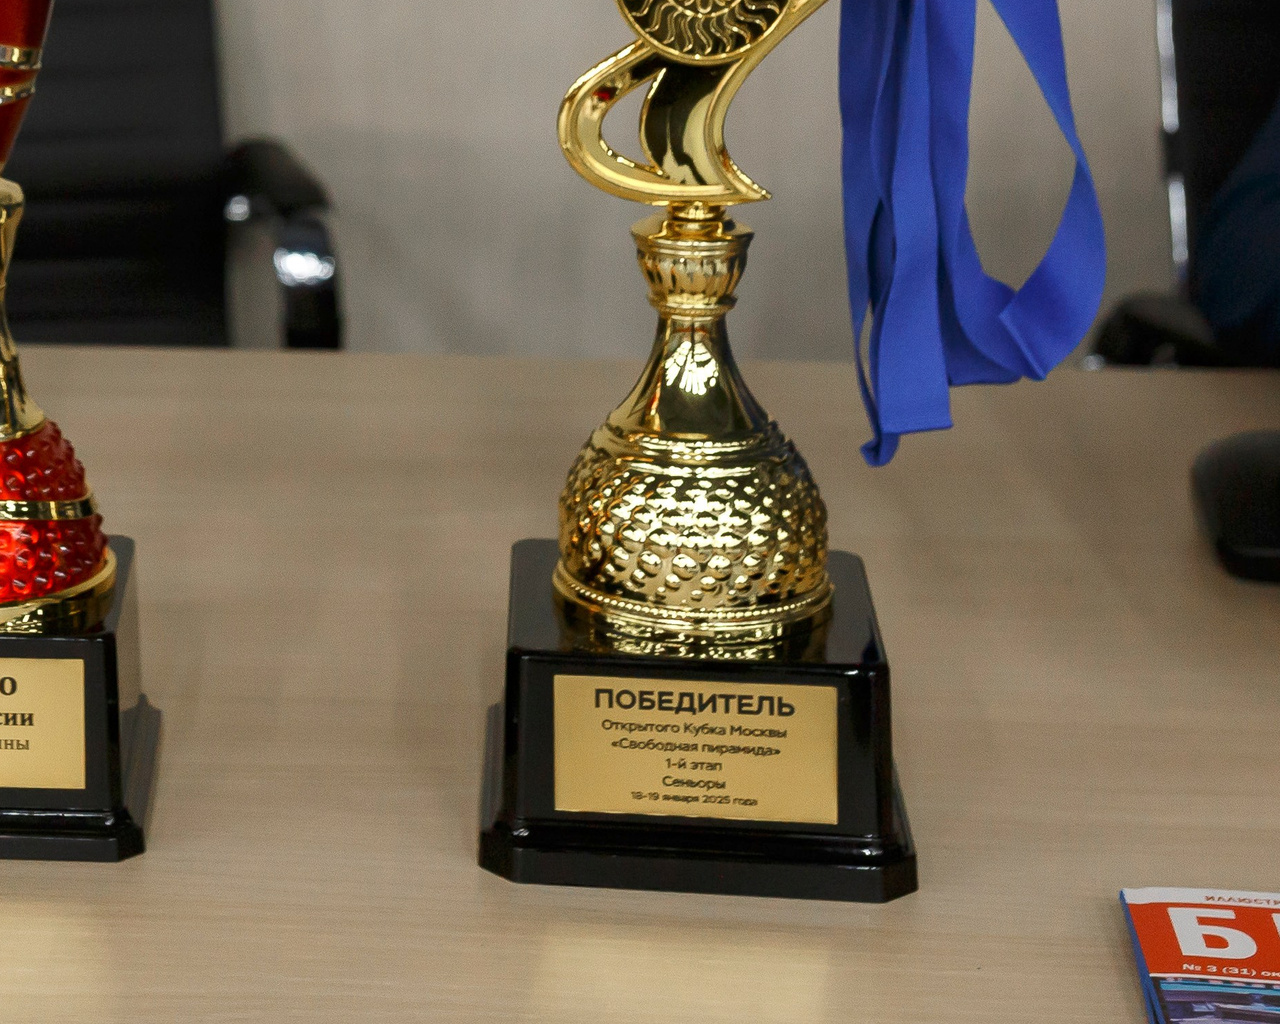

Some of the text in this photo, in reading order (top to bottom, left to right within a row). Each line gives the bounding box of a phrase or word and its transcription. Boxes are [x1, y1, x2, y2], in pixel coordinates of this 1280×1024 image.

[594, 688, 796, 718] ПОБЕДИТЕЛЬ
[601, 719, 788, 739] Открытого Кубка Москвы
[611, 738, 781, 757] «Свободная пирамида»
[665, 758, 723, 772] 1-й этап
[662, 775, 726, 791] Сеньоры
[631, 791, 659, 801] 18-19
[662, 794, 699, 805] января
[702, 795, 731, 805] 2025
[1182, 963, 1202, 972] №
[1206, 964, 1218, 973] 3
[1222, 965, 1257, 977] (31)
